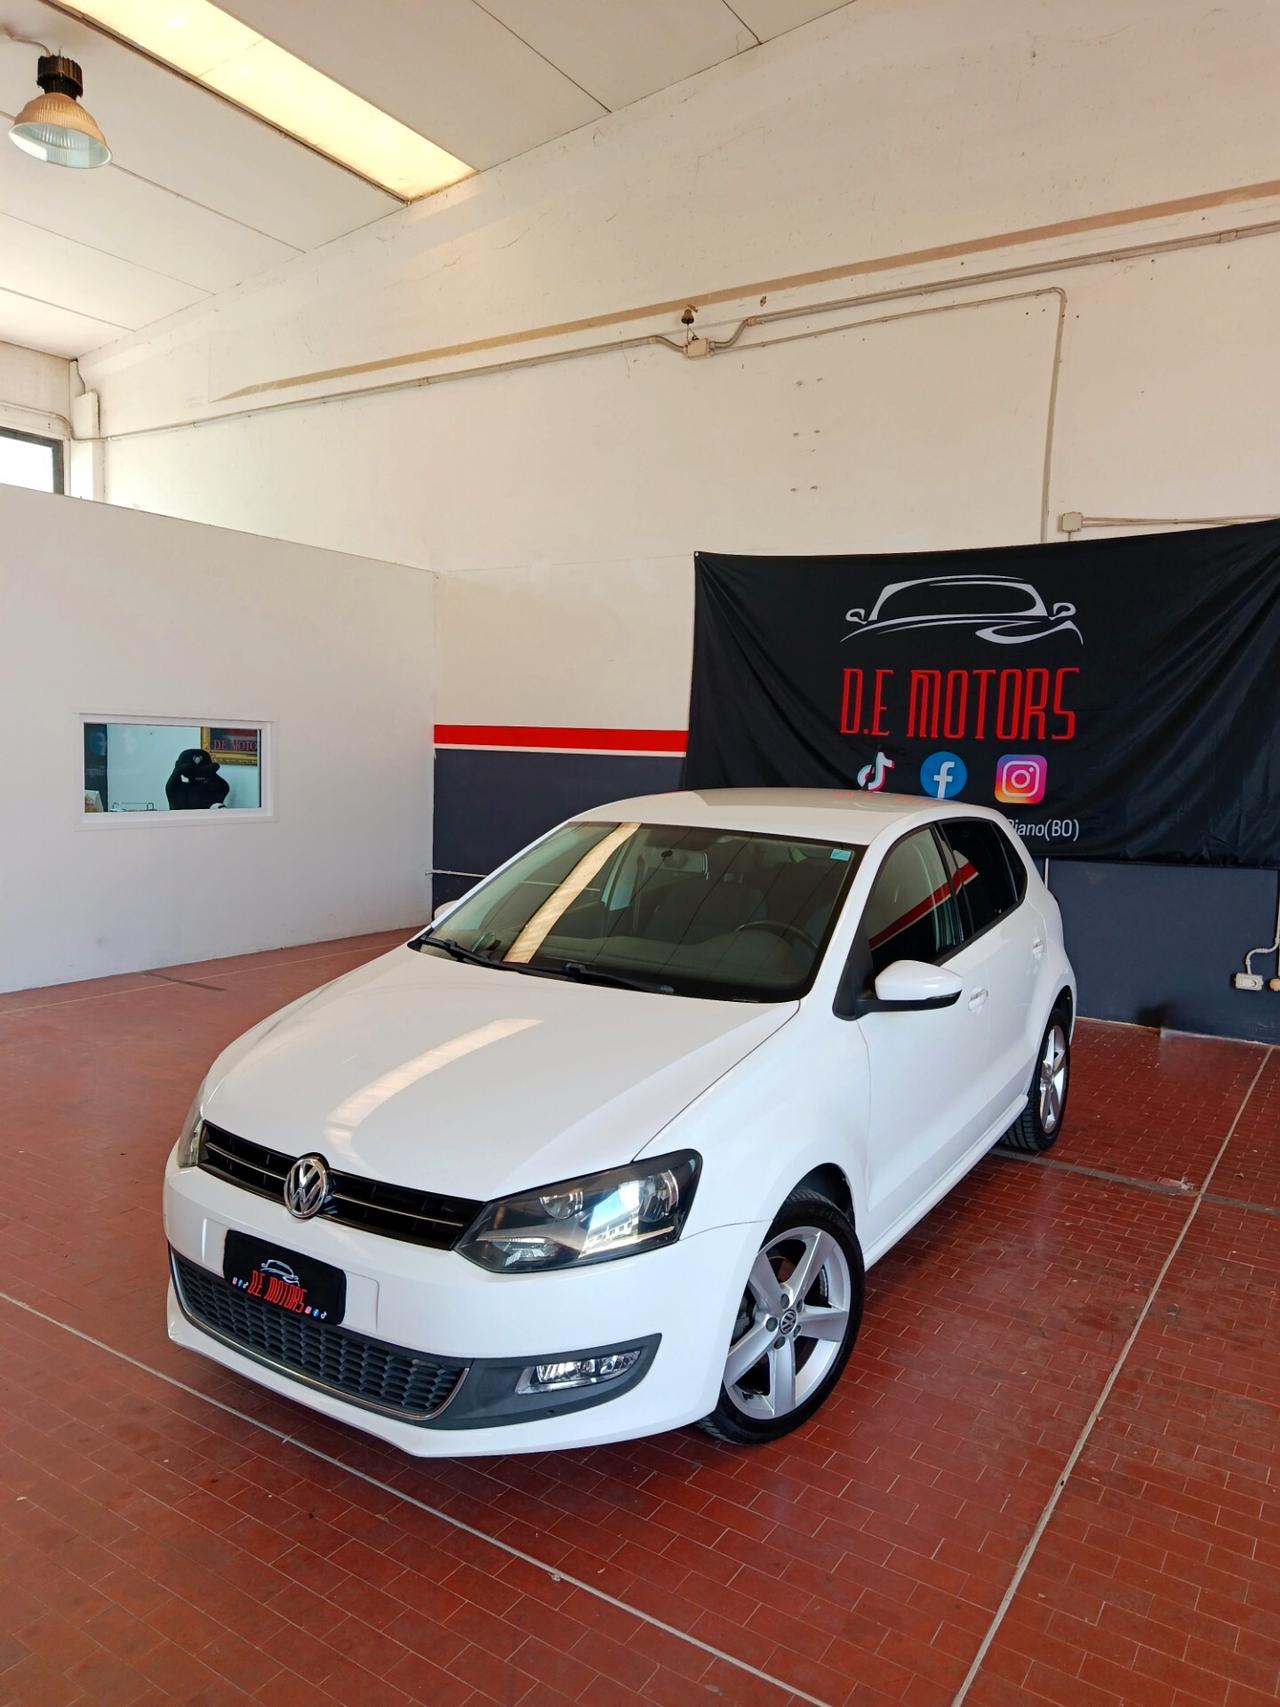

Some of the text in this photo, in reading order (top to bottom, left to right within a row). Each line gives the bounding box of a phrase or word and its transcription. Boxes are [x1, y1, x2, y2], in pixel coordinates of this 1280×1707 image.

[840, 667, 1080, 740] D.E MOTORS
[265, 1277, 307, 1313] MOTORS
